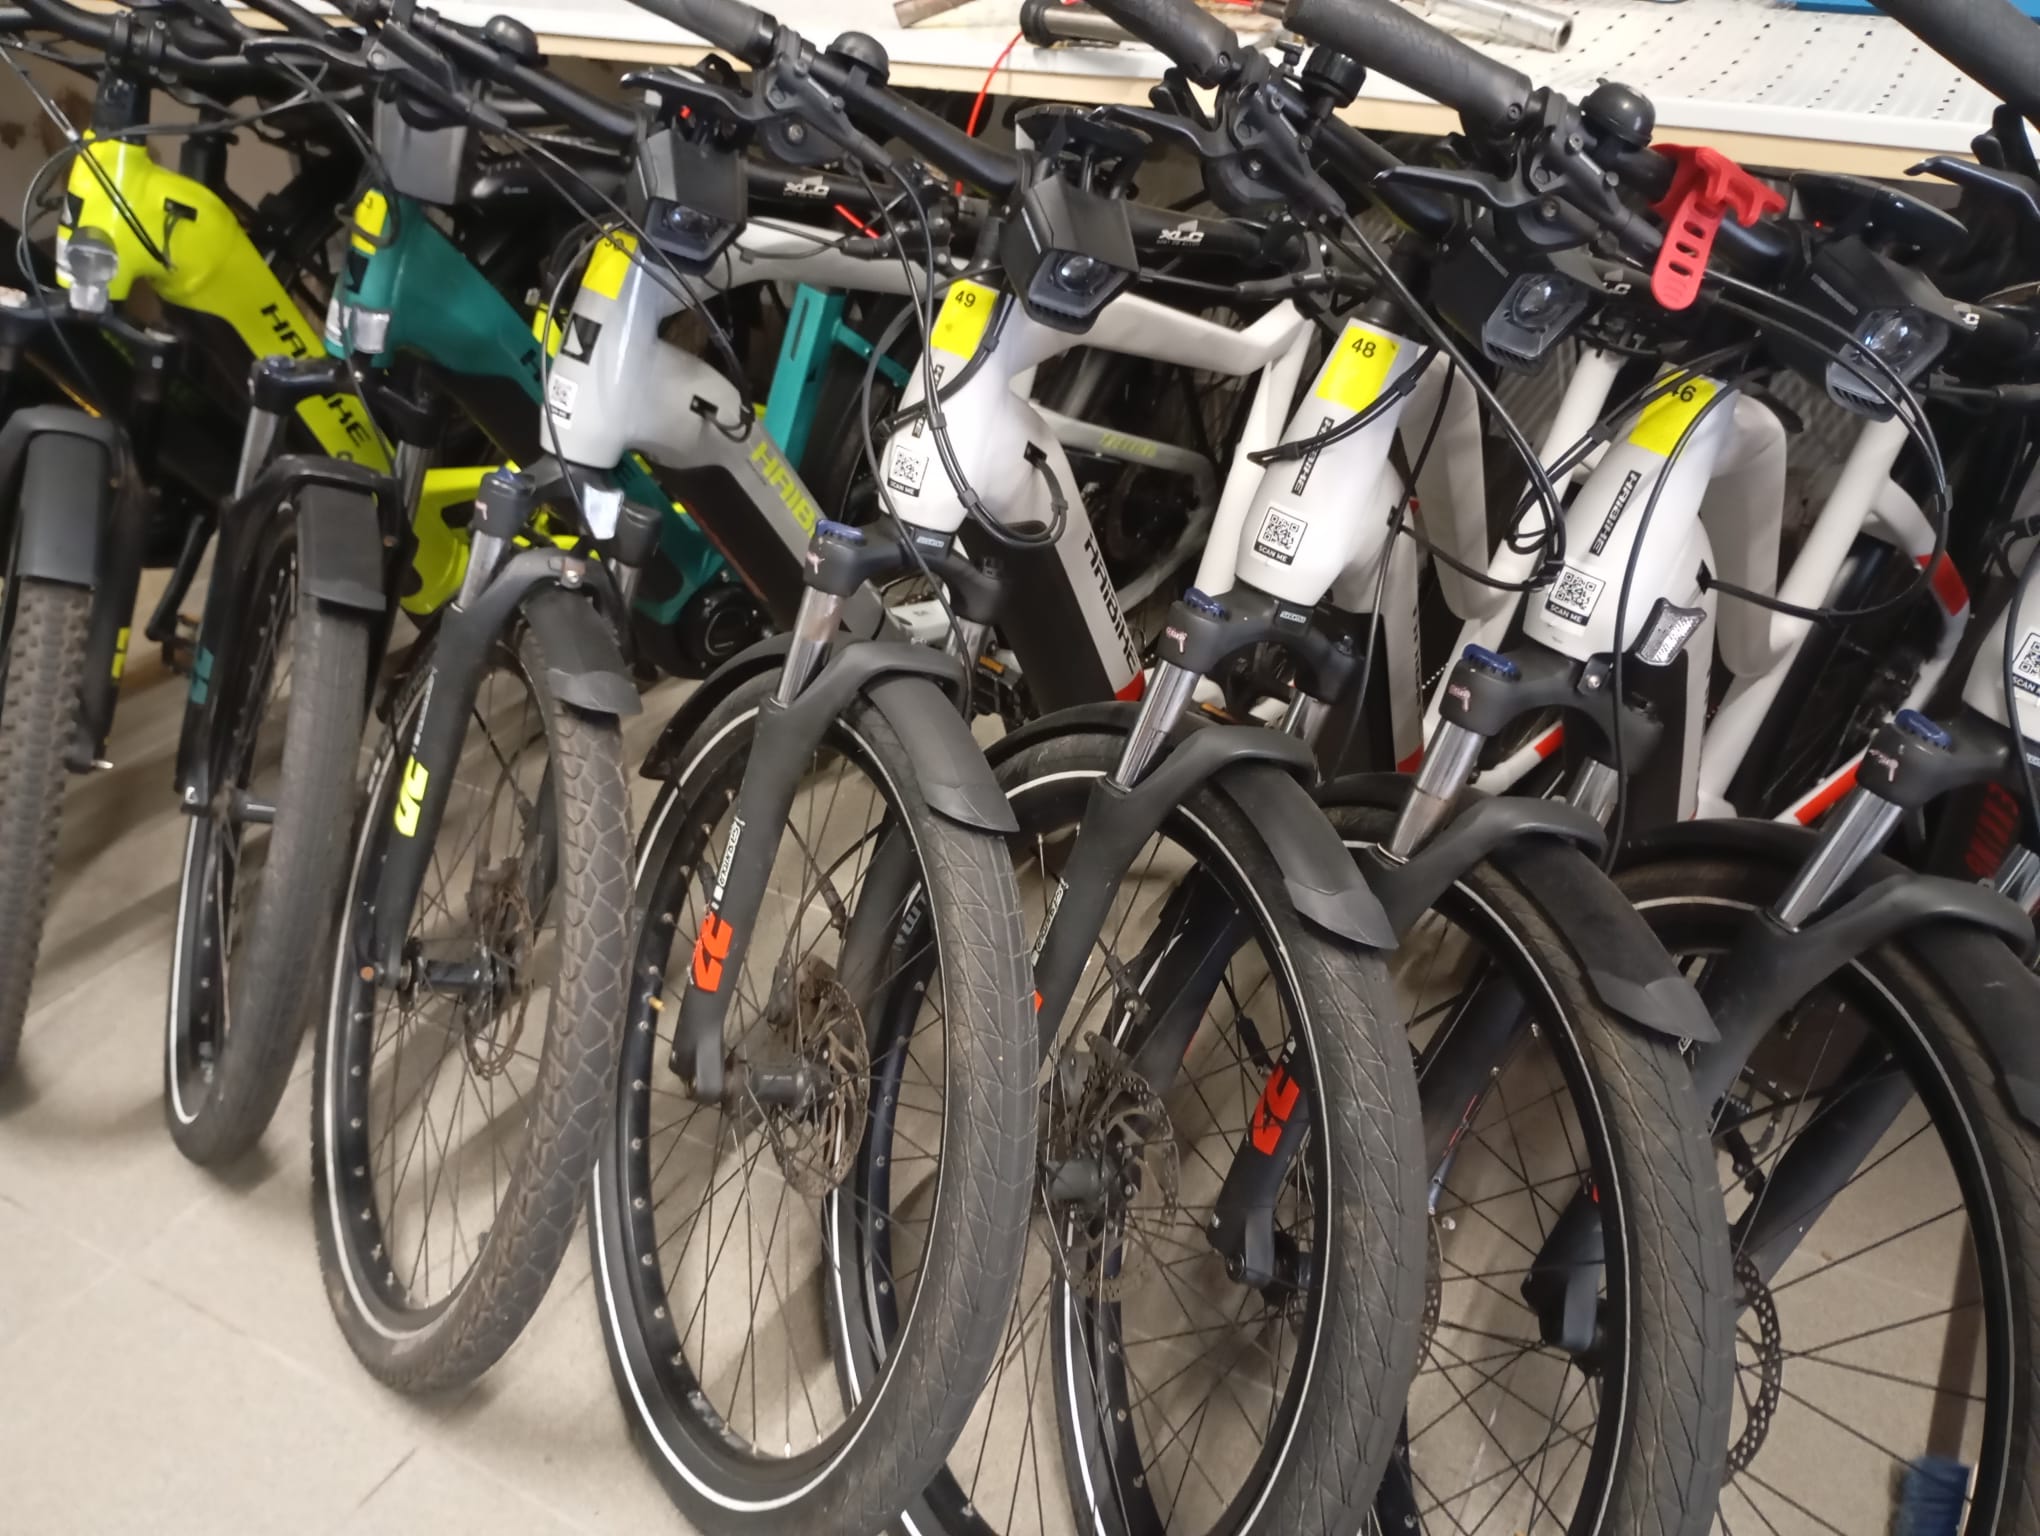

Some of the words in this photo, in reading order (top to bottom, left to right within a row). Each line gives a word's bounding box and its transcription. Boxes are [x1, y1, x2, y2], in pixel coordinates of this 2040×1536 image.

[955, 290, 976, 308] 49
[1351, 338, 1376, 359] 48
[1592, 471, 1640, 554] HAIBIKE
[1259, 544, 1276, 559] SCAN
[1085, 532, 1138, 675] HAIBIKE
[1550, 603, 1570, 618] SCAN
[1570, 612, 1582, 622] ME
